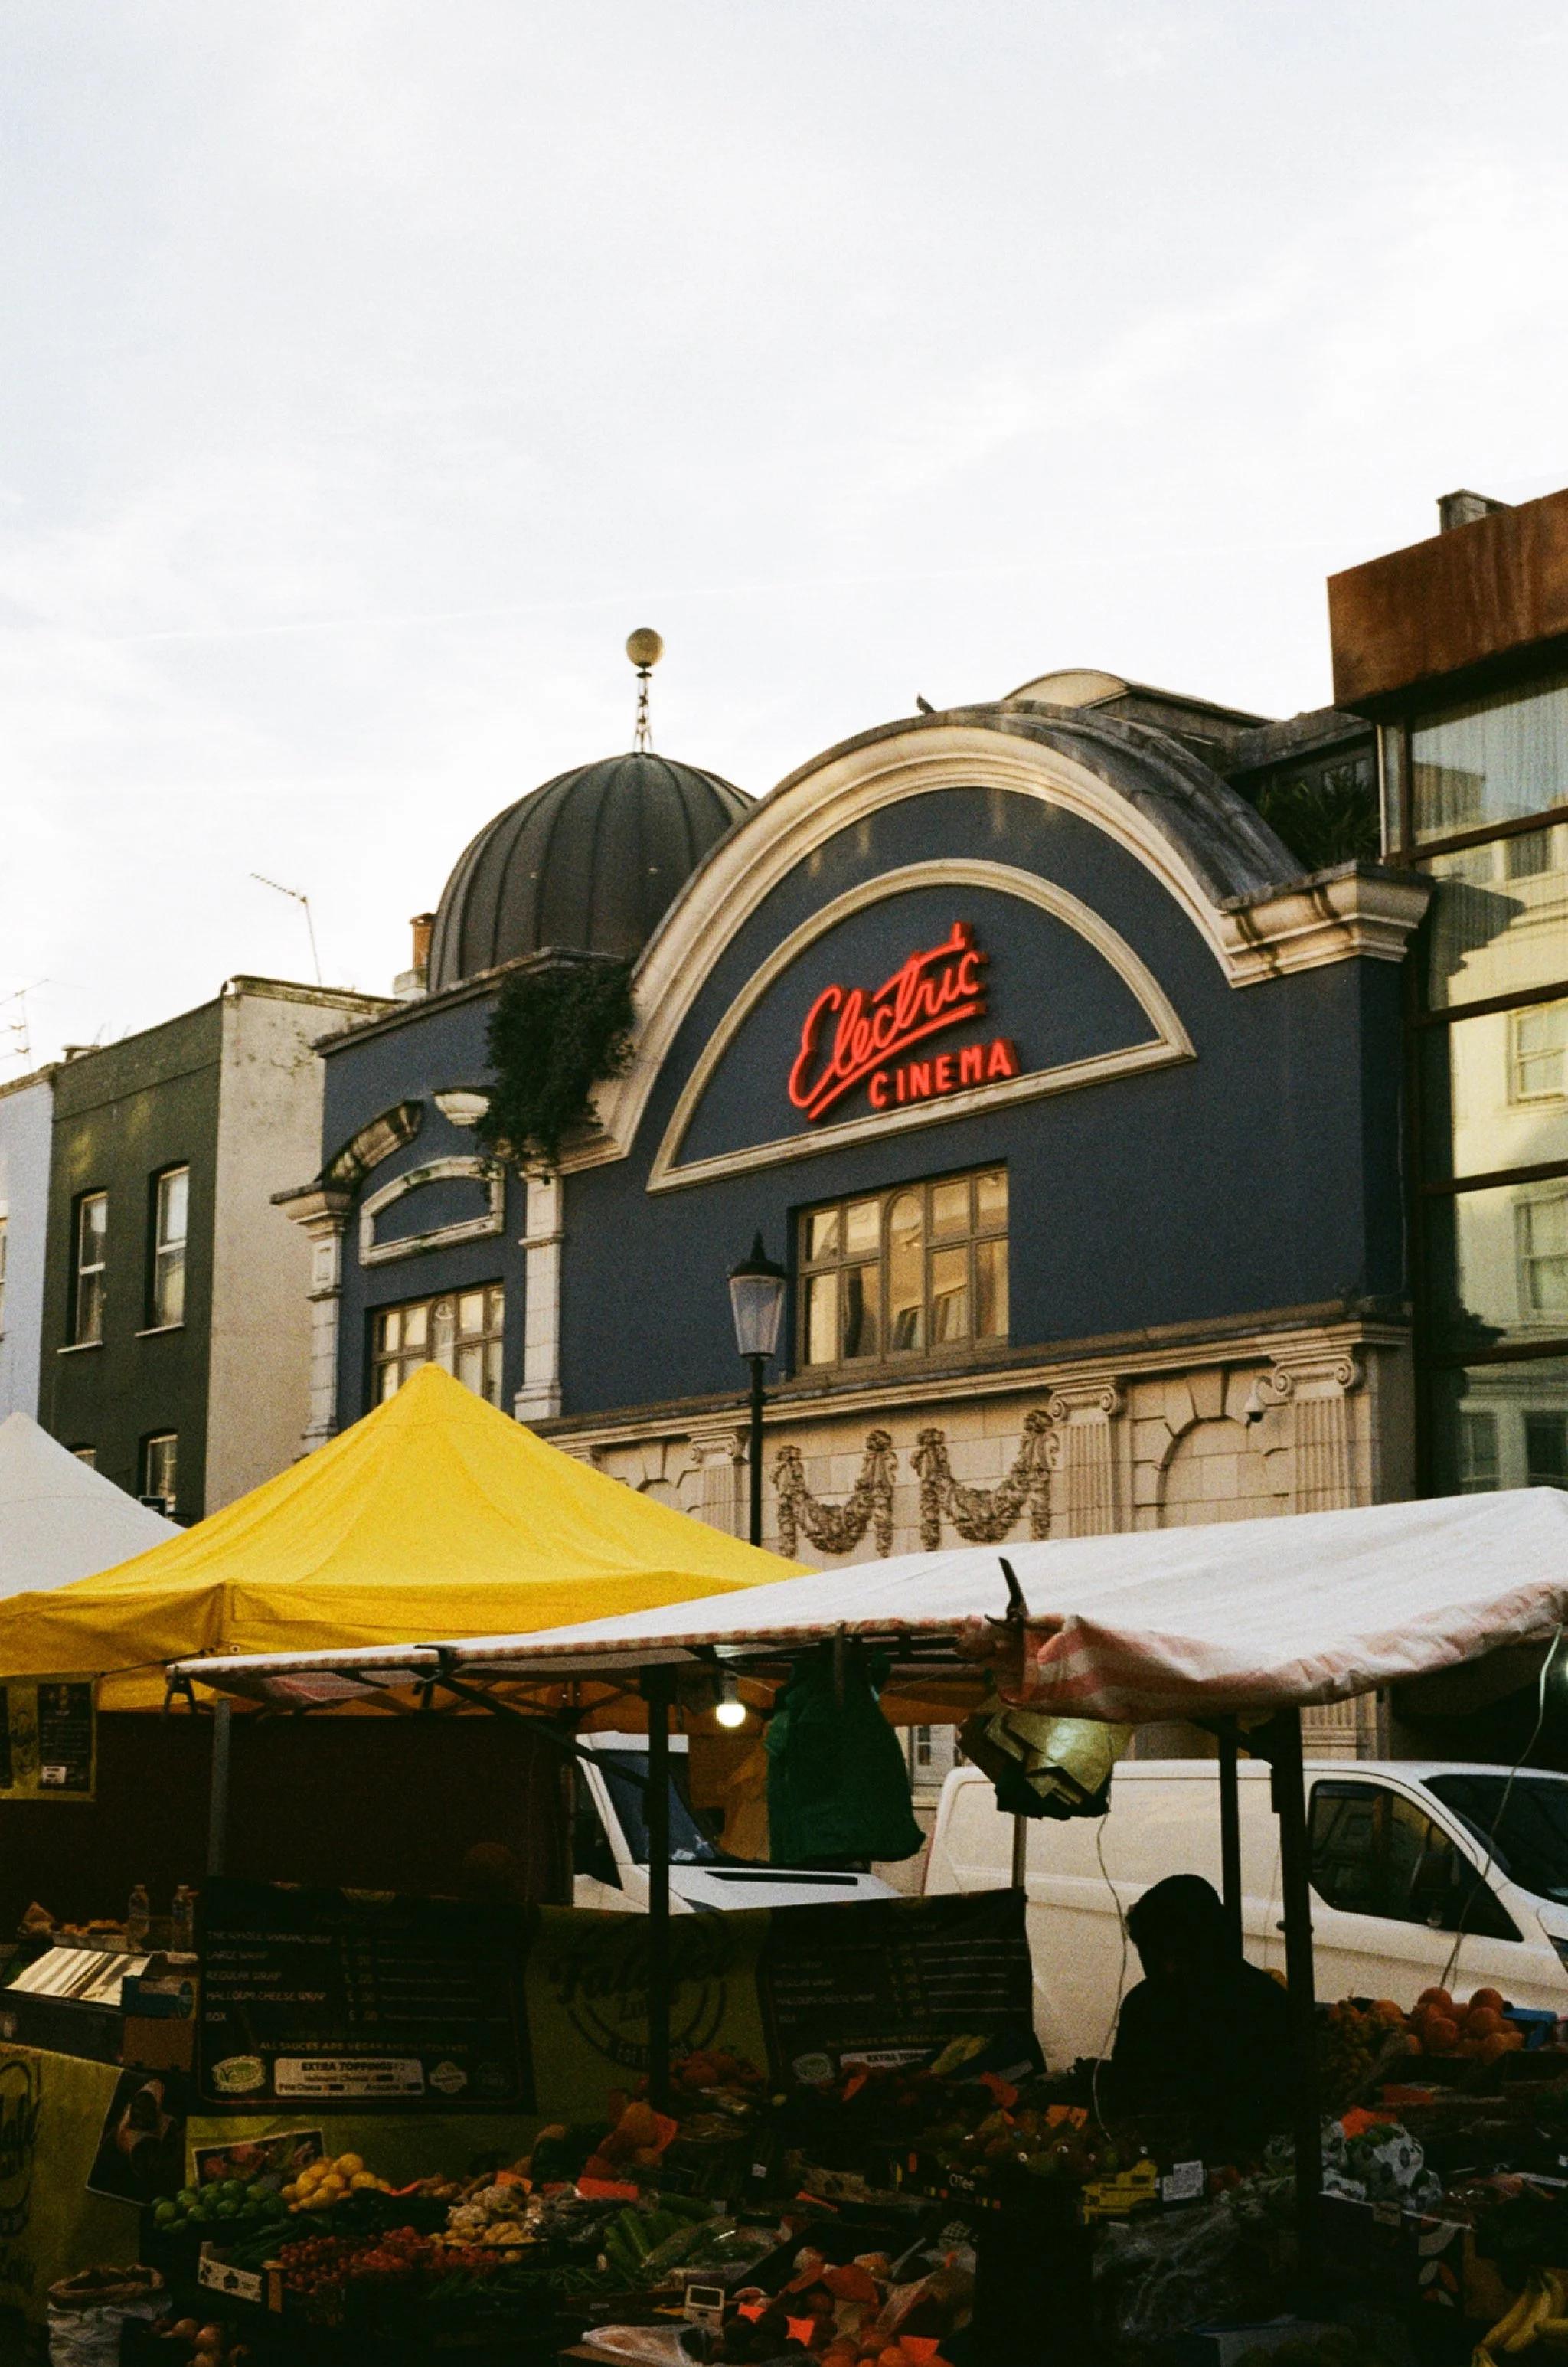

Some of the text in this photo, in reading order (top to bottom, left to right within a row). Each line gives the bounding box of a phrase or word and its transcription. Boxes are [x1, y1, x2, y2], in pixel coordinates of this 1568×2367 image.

[789, 921, 986, 1110] Electric
[869, 1038, 1020, 1110] CINEMA
[205, 2011, 228, 2022] BOX
[259, 2041, 278, 2051] ALL
[279, 2042, 319, 2052] SAUCES
[322, 2042, 345, 2052] ARE
[302, 2062, 336, 2071] EXTRA
[339, 2061, 393, 2071] TOPPINGS
